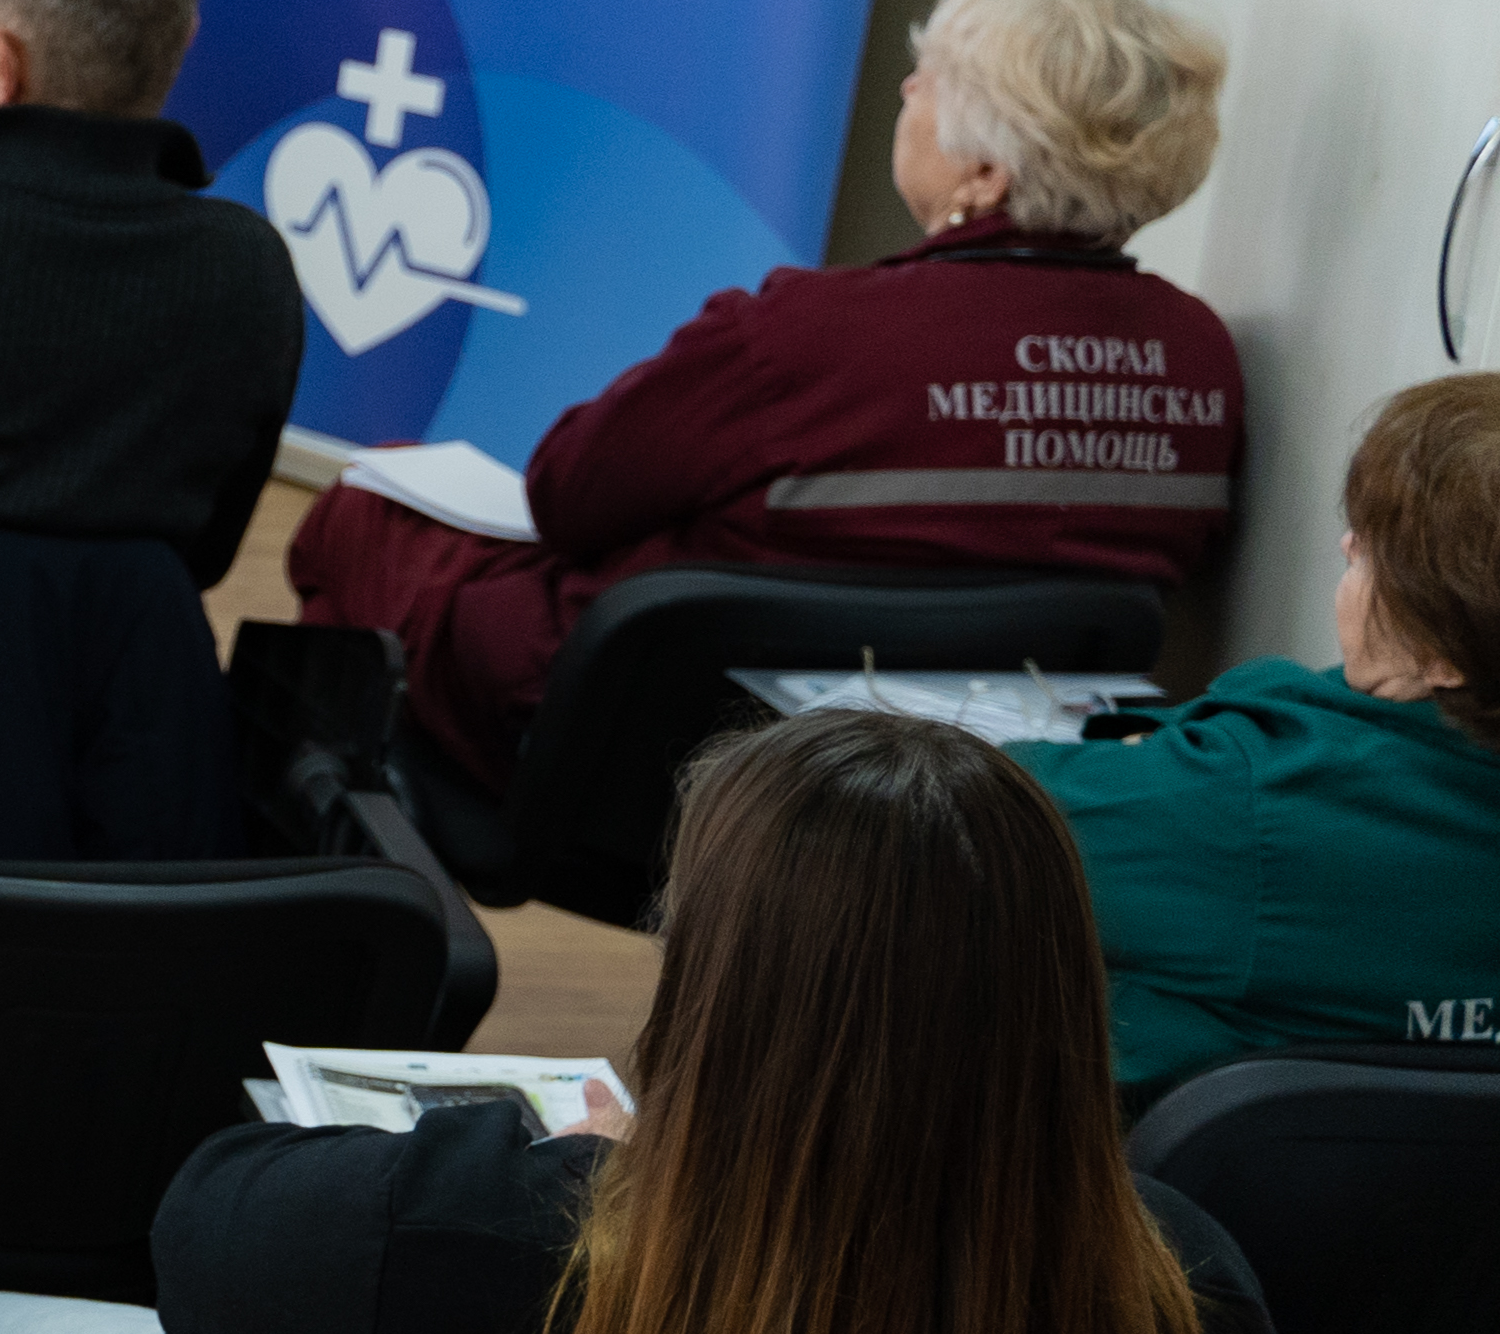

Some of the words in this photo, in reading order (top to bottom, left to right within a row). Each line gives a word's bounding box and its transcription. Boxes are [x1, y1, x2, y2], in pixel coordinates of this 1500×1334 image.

[1015, 334, 1166, 376] СКОРАЯ
[927, 381, 1226, 427] МЕДИЦИНСКАЯ
[1004, 429, 1179, 472] ПОМОЩЬ
[1406, 997, 1500, 1044] МЕ
